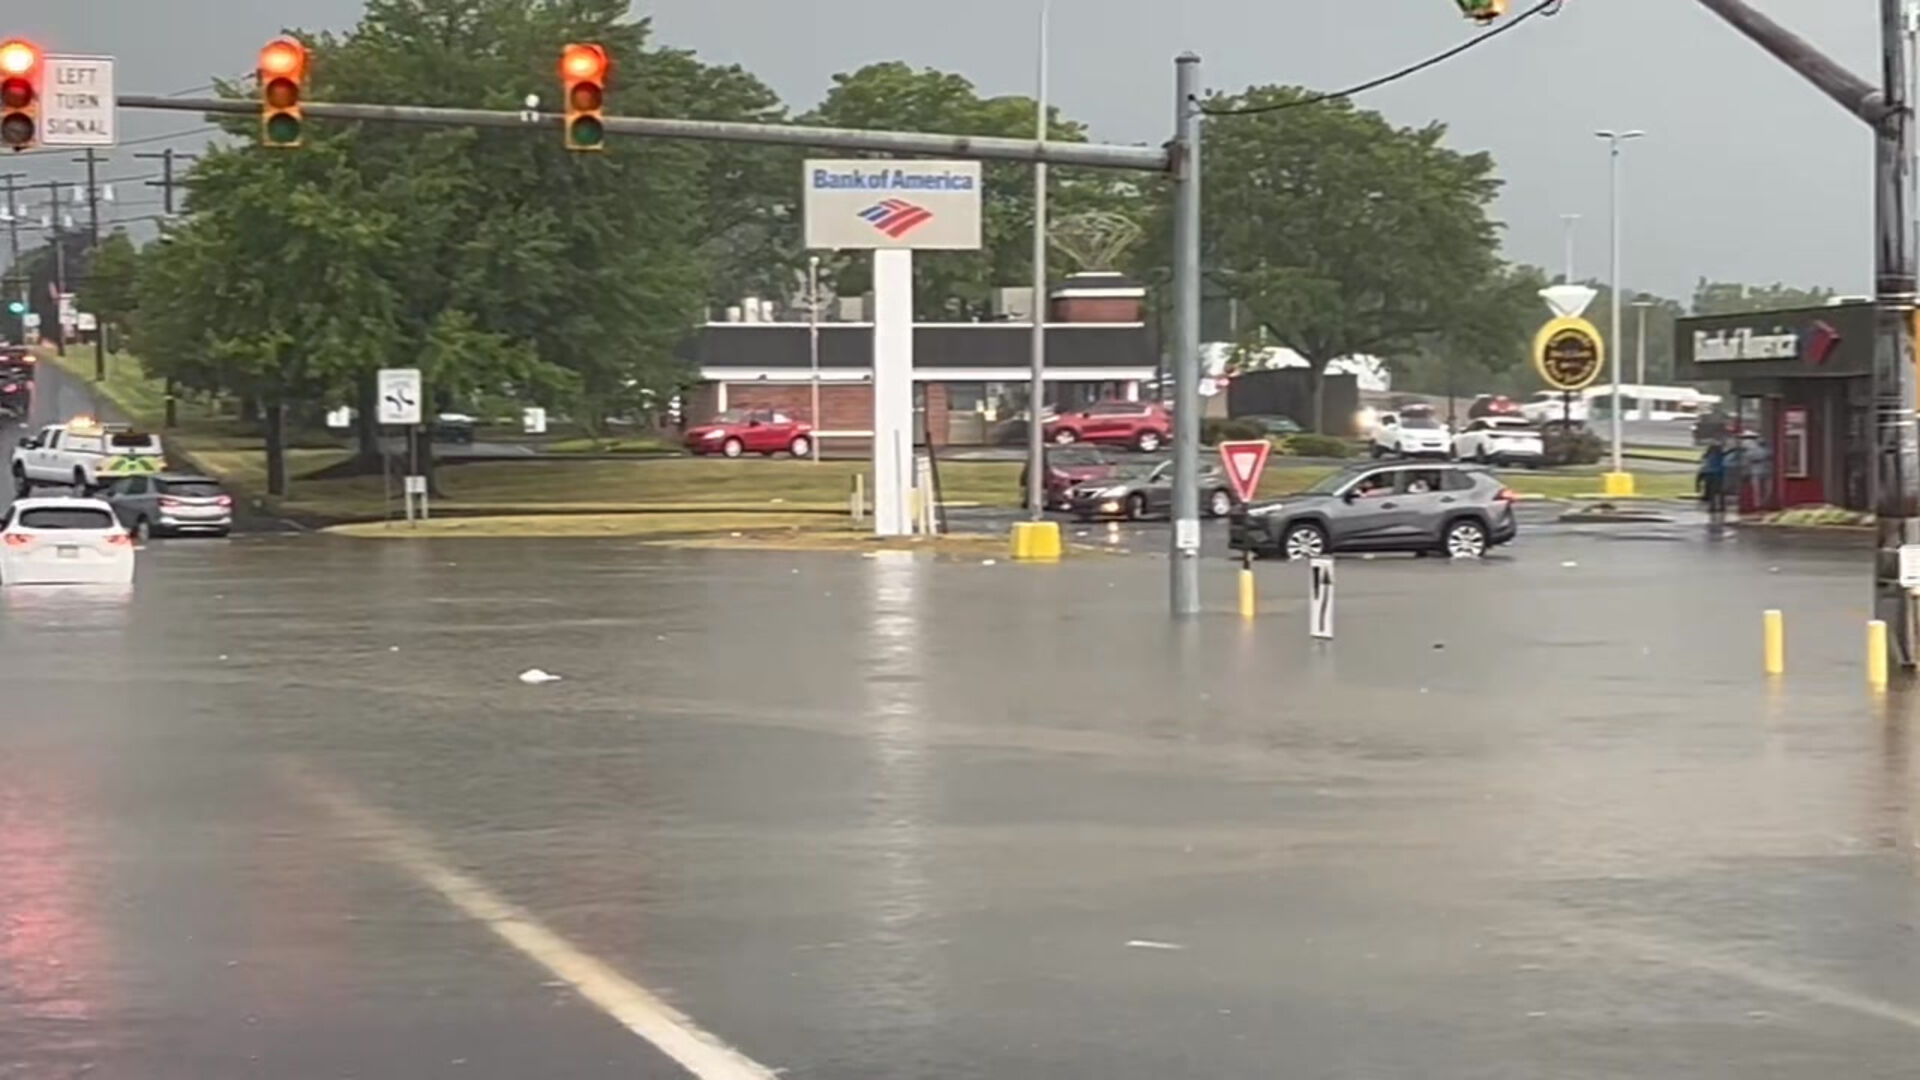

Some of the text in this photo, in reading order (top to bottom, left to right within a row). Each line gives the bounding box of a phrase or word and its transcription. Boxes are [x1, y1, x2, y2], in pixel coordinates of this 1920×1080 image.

[56, 67, 97, 85] LEFT
[56, 93, 100, 110] TURN
[47, 118, 108, 135] SIGNAL
[813, 169, 973, 191] Bank of America
